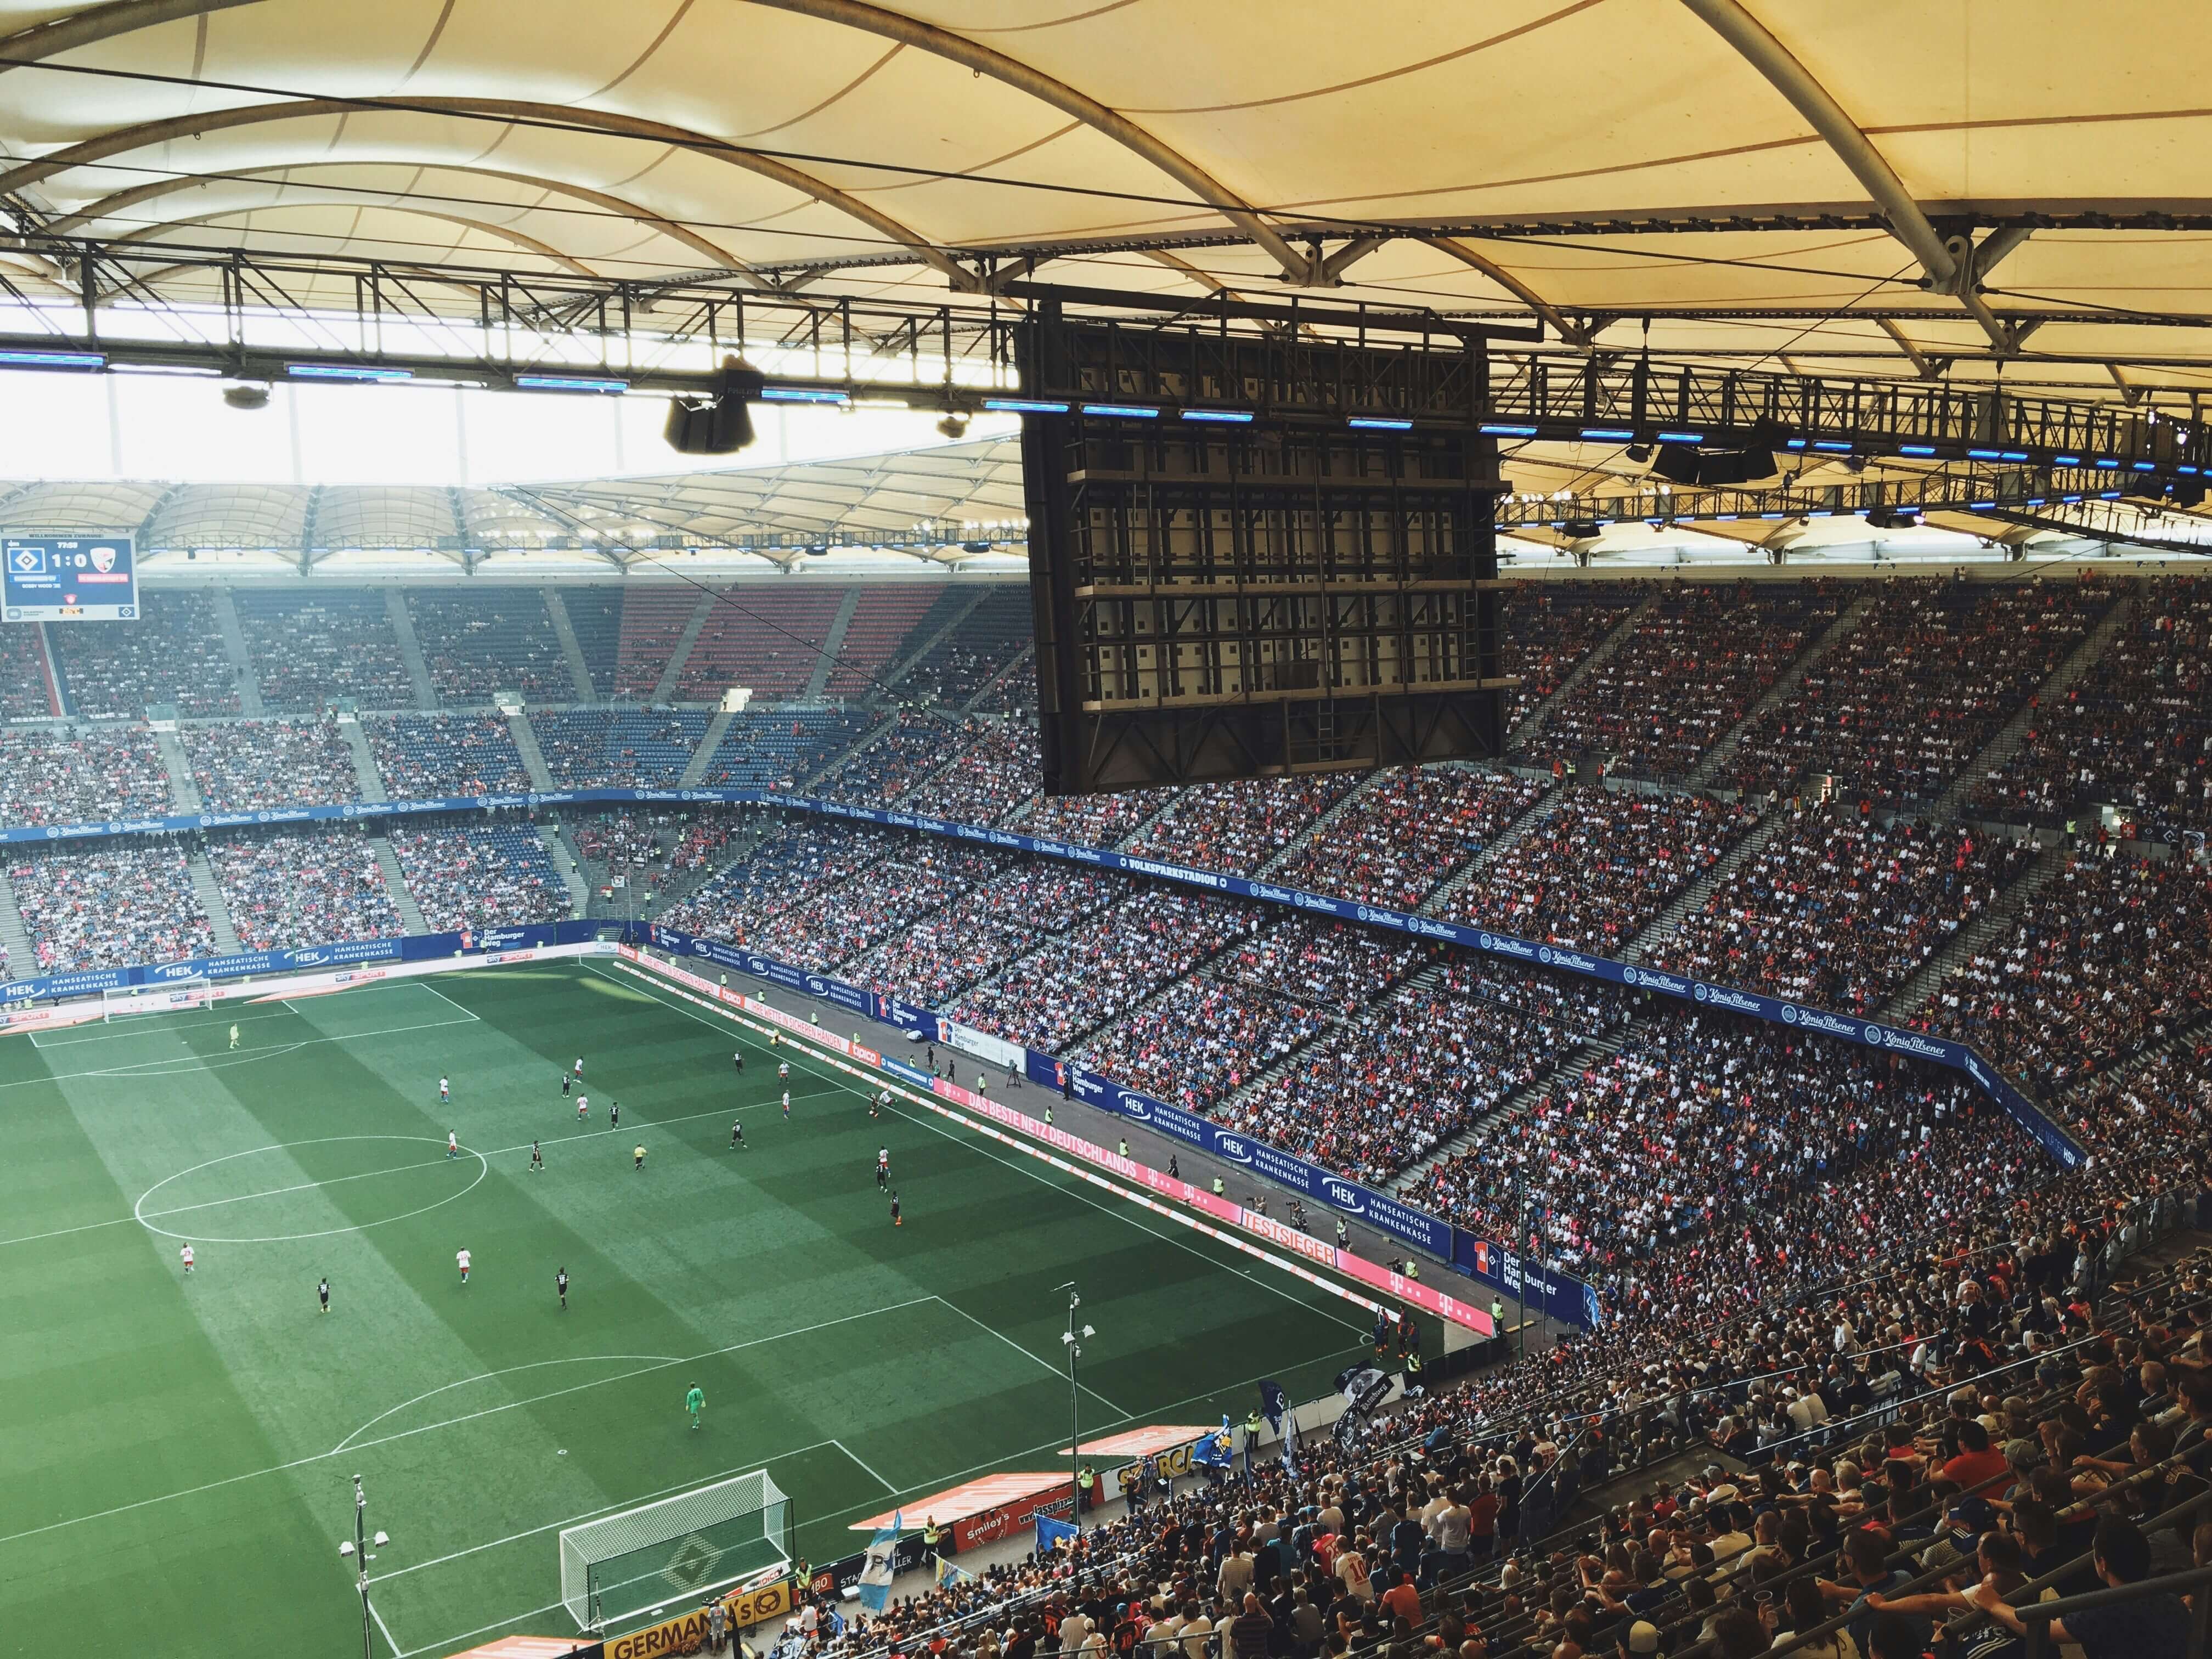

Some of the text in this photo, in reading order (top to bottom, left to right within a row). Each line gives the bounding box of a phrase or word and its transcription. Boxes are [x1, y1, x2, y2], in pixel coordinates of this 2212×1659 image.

[52, 553, 61, 567] 1
[74, 553, 87, 567] 0
[1129, 859, 1217, 886] VOLKSPARKSTADION
[484, 932, 525, 941] Hamburger
[1435, 923, 1457, 938] Pilsener
[334, 949, 393, 960] KRANKENKASSE
[335, 942, 391, 952] HANSEATISCHE
[696, 940, 707, 952] HEK
[1509, 939, 1533, 956] Pilsener
[209, 955, 268, 967] HANSEATISCHE
[296, 952, 319, 962] HEK
[1552, 951, 1595, 970] König Pilsener
[166, 966, 192, 977] HEK
[208, 962, 270, 974] KRANKENKASSE
[752, 961, 764, 971] HEK
[51, 980, 119, 993] KRANKENKASSE
[52, 973, 117, 985] HANSEATISCHE
[811, 980, 823, 991] HEK
[1638, 970, 1686, 994] König Pilsener
[7, 984, 35, 996] HEK
[831, 984, 861, 999] HANSEATISCHE
[1708, 988, 1760, 1012] König Pilsener
[751, 1000, 763, 1016] IHRE
[763, 1006, 781, 1023] WETTE
[782, 1013, 788, 1025] IN
[789, 1016, 816, 1037] SICHEREN
[893, 1007, 917, 1023] Hamburger
[893, 1014, 903, 1025] Weg
[1798, 1009, 1856, 1036] König Pilsener
[955, 1032, 979, 1047] Hamburger
[1883, 1030, 1945, 1058] König Pilsener
[852, 1043, 876, 1063] tipico
[1073, 1066, 1082, 1077] Der
[1073, 1075, 1103, 1093] Hamburger
[1073, 1083, 1085, 1096] Weg
[1126, 1097, 1144, 1114] HEK
[1155, 1105, 1200, 1130] HANSEATISCHE
[969, 1094, 1136, 1177] DAS BESTE NETZ DEUTSCHLANDS
[1154, 1115, 1201, 1142] KRANKENKASSE
[1223, 1137, 1244, 1157] HEK
[1257, 1149, 1308, 1176] HANSEATISCHE
[2063, 1147, 2075, 1165] HSV
[1256, 1159, 1309, 1188] KRANKENKASSE
[1332, 1184, 1356, 1206] HEK
[1370, 1198, 1430, 1231] HANSEATISCHE
[1369, 1209, 1431, 1244] KRANKENKASSE
[1243, 1210, 1335, 1266] TESTSIEGER
[1504, 1251, 1520, 1267] Der
[967, 1513, 1009, 1540] Smiley's
[1350, 1560, 1368, 1582] 10
